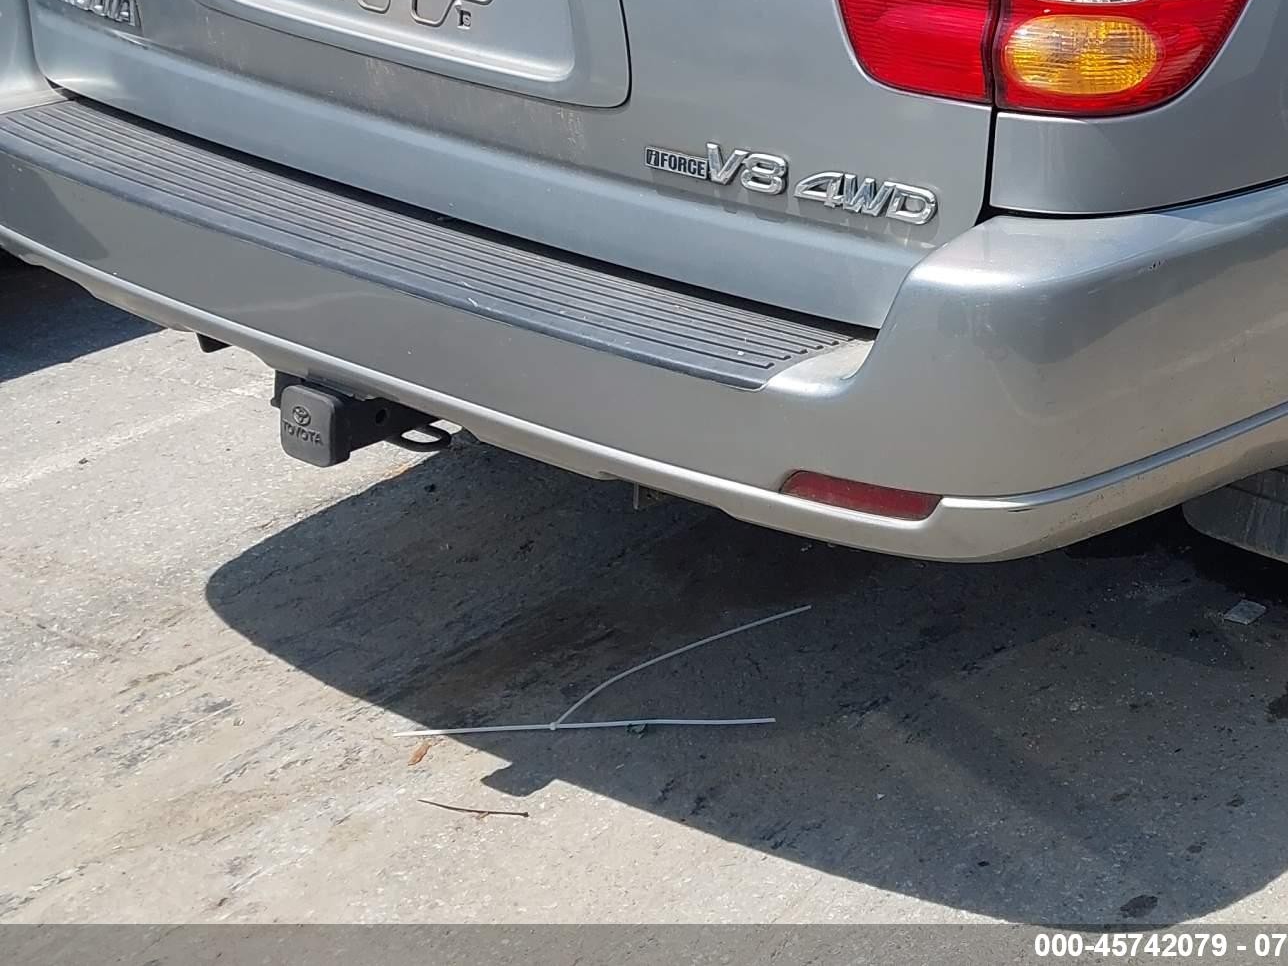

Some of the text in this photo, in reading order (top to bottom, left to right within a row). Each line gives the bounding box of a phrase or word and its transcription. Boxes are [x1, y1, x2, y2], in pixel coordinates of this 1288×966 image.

[706, 142, 788, 195] V8
[793, 171, 938, 225] 4WD
[281, 418, 324, 446] TOYOTA
